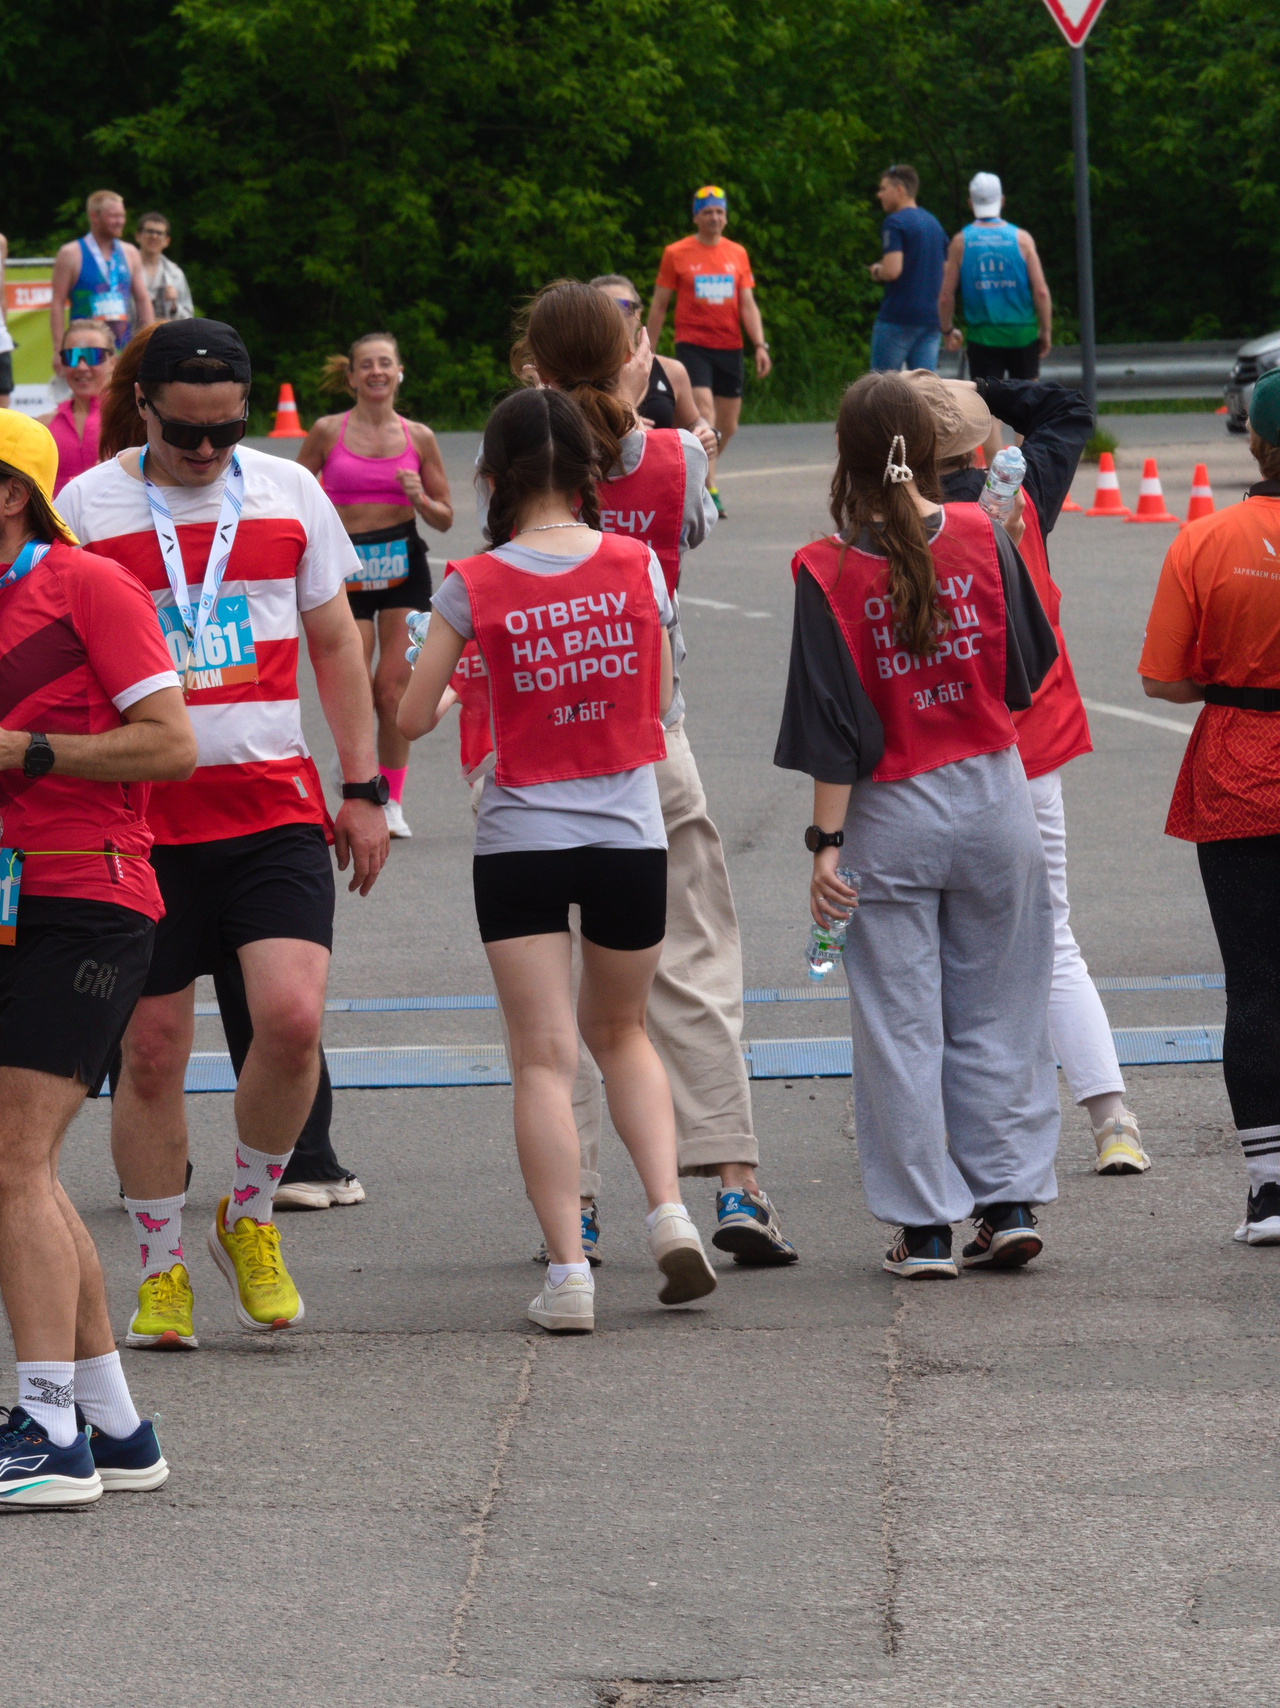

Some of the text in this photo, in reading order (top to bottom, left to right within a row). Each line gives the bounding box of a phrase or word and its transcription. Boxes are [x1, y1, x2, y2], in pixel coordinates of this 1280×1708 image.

[346, 554, 405, 581] 0020
[505, 591, 627, 635] ОТВЕЧУ
[512, 622, 634, 665] НА ВАШ
[512, 651, 639, 693] ВОПРОС
